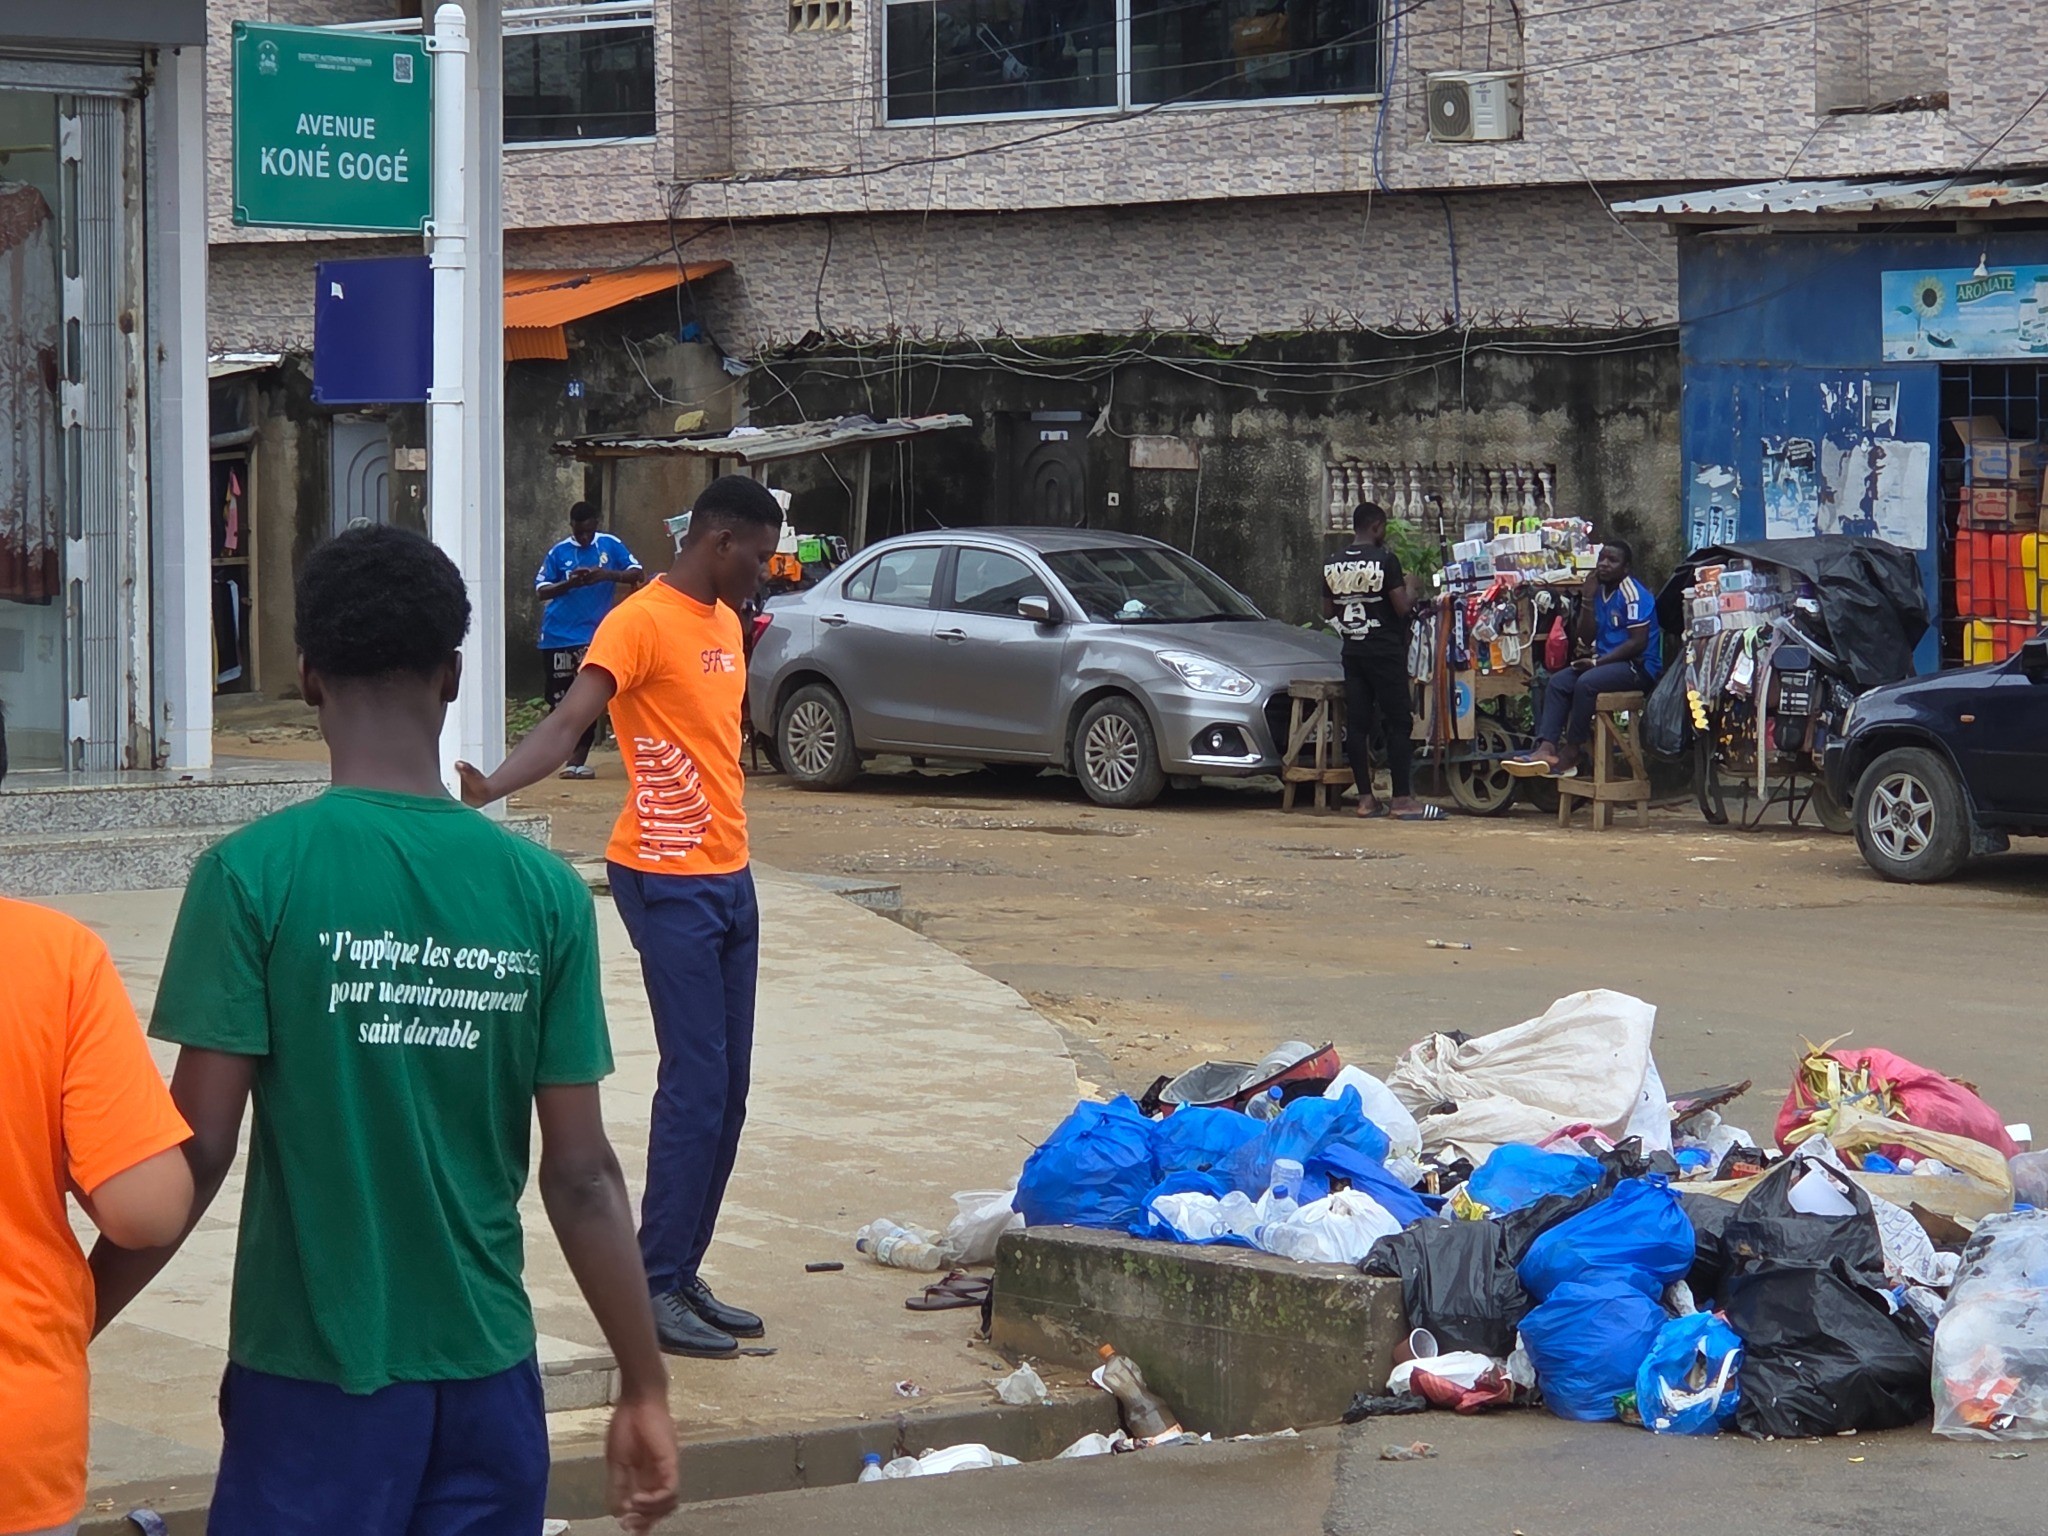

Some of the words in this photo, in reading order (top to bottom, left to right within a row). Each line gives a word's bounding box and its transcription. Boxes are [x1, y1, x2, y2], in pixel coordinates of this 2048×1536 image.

[296, 113, 376, 139] AVENUE
[260, 143, 330, 178] KONÉ
[338, 148, 409, 182] GOGÉ
[1957, 275, 2015, 300] AROMATE
[421, 936, 451, 967] les
[329, 981, 374, 1013] pour
[403, 1016, 481, 1050] durable
